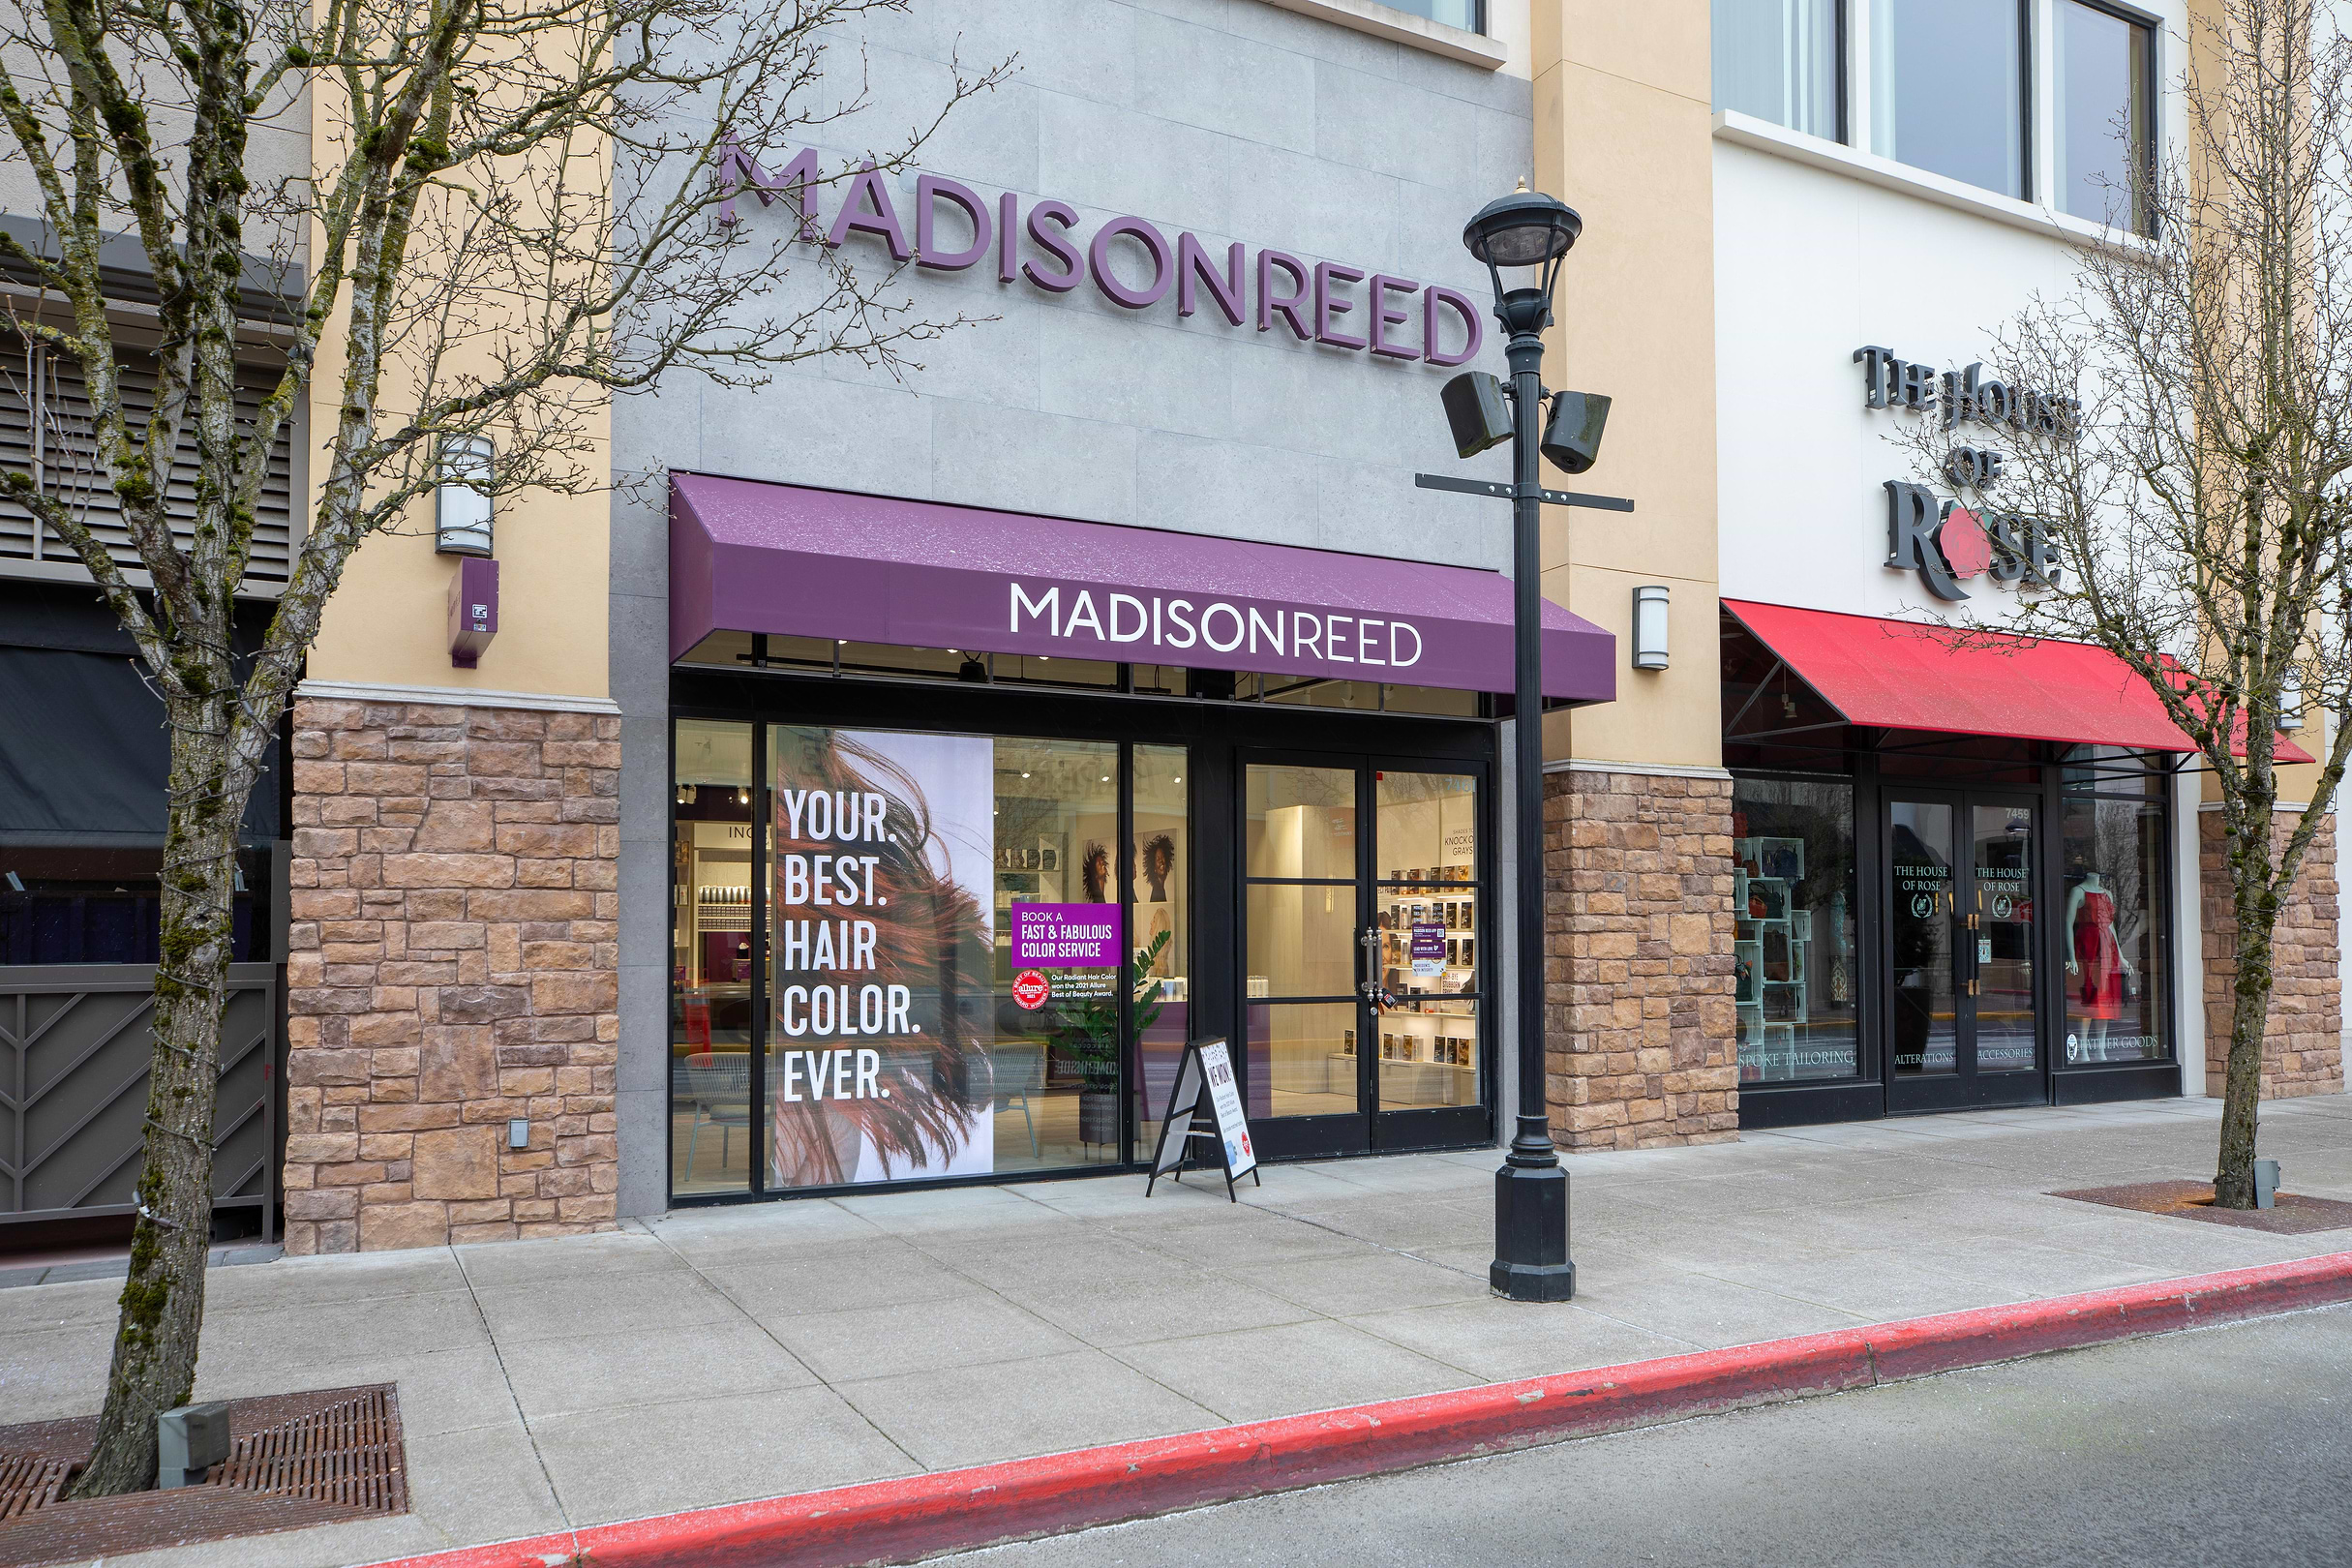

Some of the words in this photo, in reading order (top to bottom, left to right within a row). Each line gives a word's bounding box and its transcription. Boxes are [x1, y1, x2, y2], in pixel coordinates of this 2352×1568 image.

[1853, 345, 1936, 411] THE
[1941, 362, 2083, 440] HOUSE
[1944, 445, 2003, 491] OF
[1009, 582, 1423, 668] MADISONREED
[1444, 778, 1476, 793] 7461
[784, 790, 897, 842] YOUR.
[2005, 808, 2030, 819] 7459
[1445, 836, 1468, 845] KNOCK
[1453, 846, 1472, 856] GRAYS
[1894, 866, 1915, 877] THE
[1915, 866, 1947, 877] HOUSE
[1975, 867, 1995, 878] THE
[1997, 867, 2027, 879] HOUSE
[785, 855, 887, 905] BEST.
[1903, 881, 1915, 890] OF
[1917, 881, 1941, 890] ROSE
[1984, 882, 1996, 891] OF
[1998, 882, 2020, 891] ROSE
[1021, 912, 1053, 921] BOOK
[1055, 912, 1064, 921] A
[1021, 925, 1045, 940] FAST
[1048, 925, 1058, 940] &
[1061, 924, 1112, 940] FABULOUS
[785, 920, 877, 970] HAIR
[1021, 943, 1056, 957] COLOR
[1058, 943, 1101, 957] SERVICE
[1018, 983, 1043, 992] allure
[784, 984, 920, 1036] COLOR.
[2077, 1038, 2120, 1051] EATHER
[2121, 1036, 2158, 1049] GOODS
[1738, 1053, 1779, 1068] SPOKE
[1783, 1050, 1854, 1066] TAILORING
[1894, 1052, 1954, 1065] ALTERATIONS
[1977, 1047, 2034, 1060] ACCESSORIES
[785, 1049, 890, 1101] EVER.
